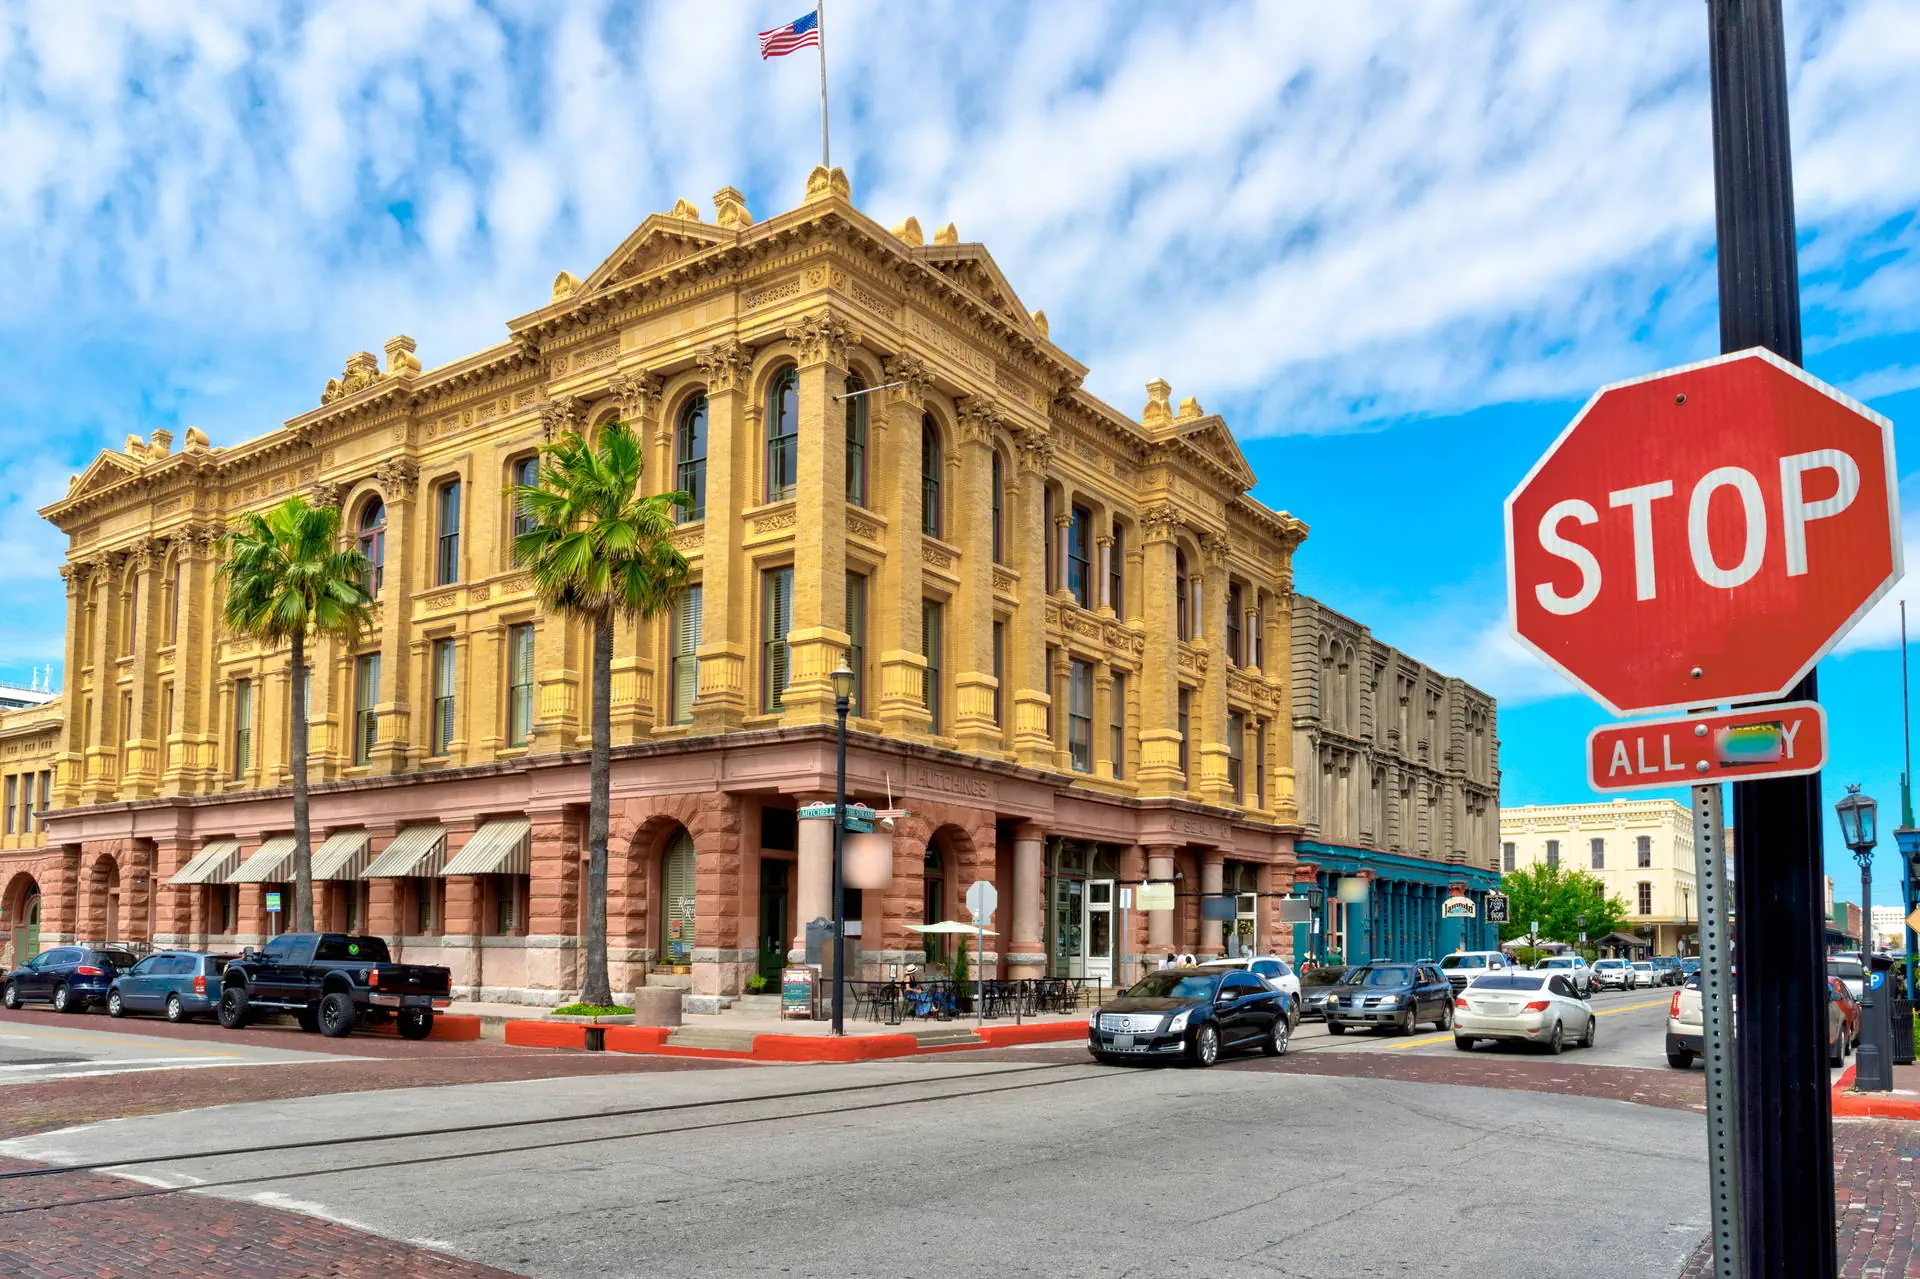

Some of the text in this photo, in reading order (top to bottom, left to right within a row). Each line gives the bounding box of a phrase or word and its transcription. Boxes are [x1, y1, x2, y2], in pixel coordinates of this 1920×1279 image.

[911, 317, 990, 377] HUTCHINGS
[1535, 448, 1860, 616] STOP
[1608, 734, 1686, 777] ALL
[917, 768, 990, 798] HUTCHINGS
[801, 807, 832, 817] MITCHELL
[1870, 974, 1880, 987] P
